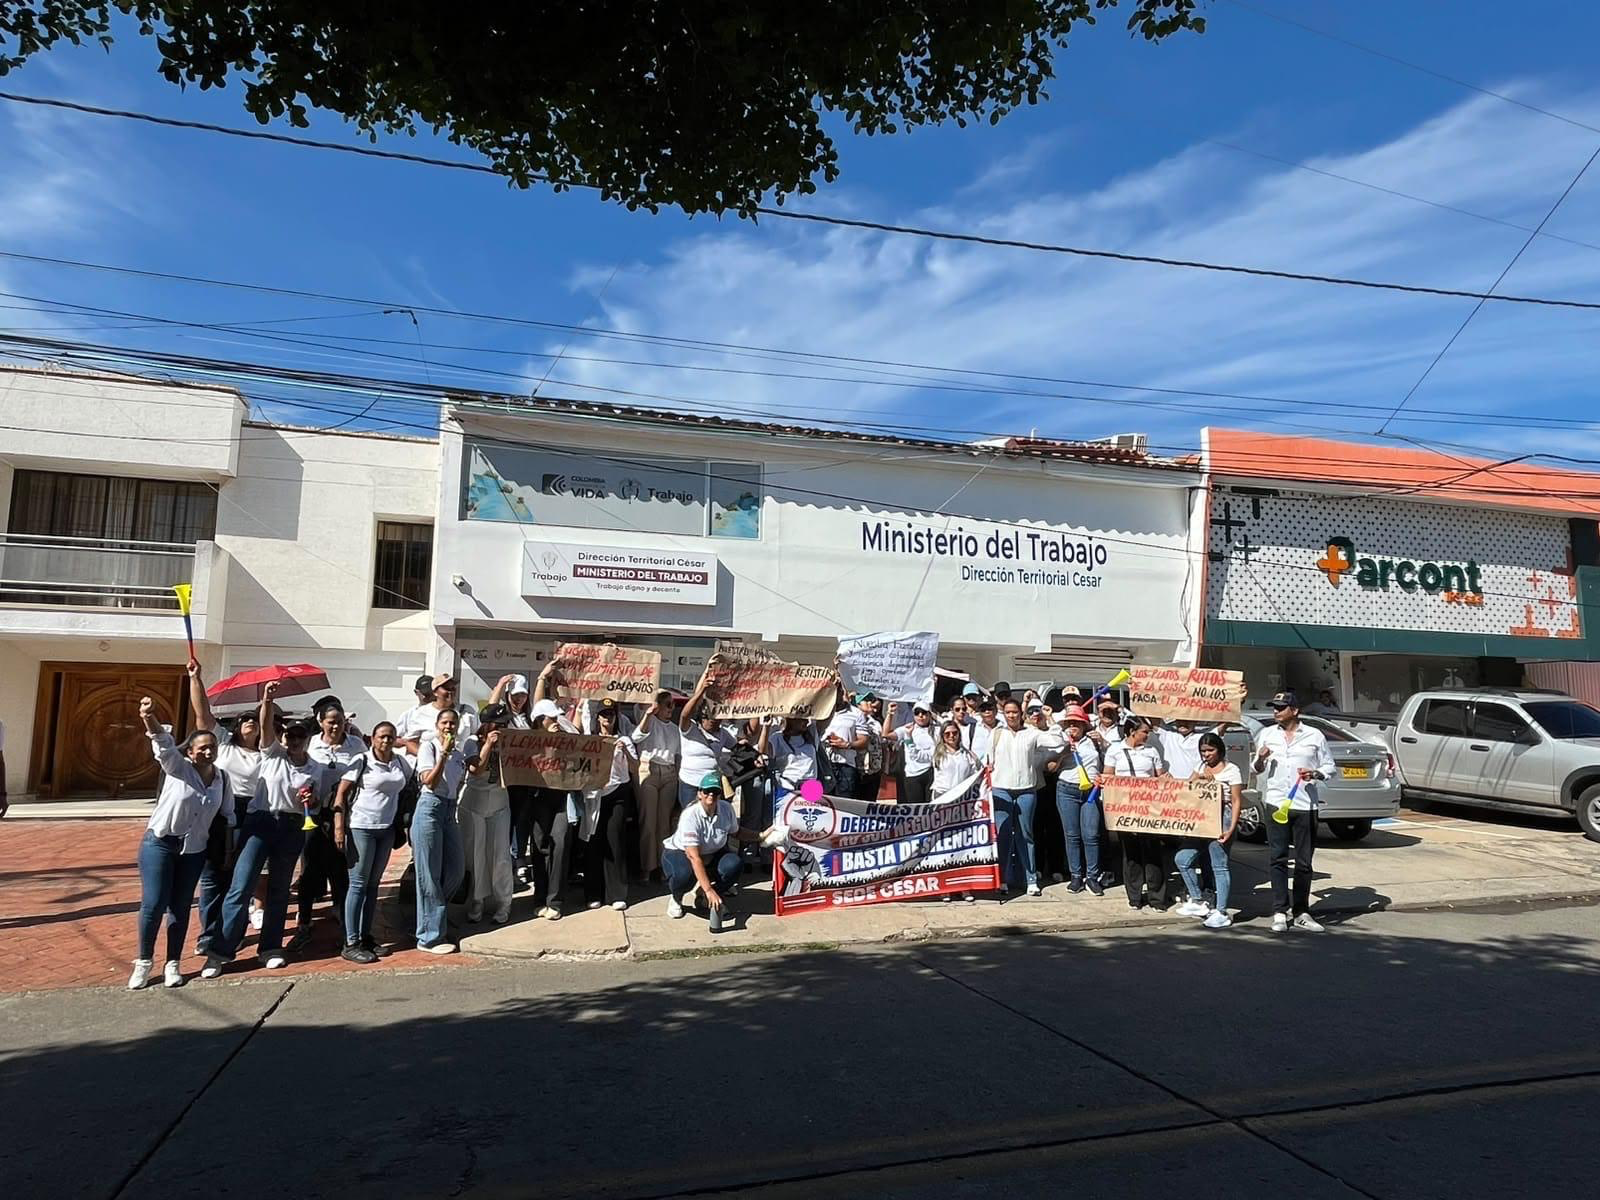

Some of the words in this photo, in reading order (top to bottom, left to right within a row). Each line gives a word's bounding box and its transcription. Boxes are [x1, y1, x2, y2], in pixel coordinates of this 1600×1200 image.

[571, 488, 605, 499] VIDA
[648, 487, 693, 502] Trabajo
[862, 521, 978, 557] Ministerio
[985, 529, 1020, 560] del
[1026, 533, 1107, 571] Trabajo
[578, 552, 625, 563] Dirección
[629, 555, 675, 566] Territorial
[532, 572, 568, 583] Trabajo
[577, 567, 635, 579] MINISTERIO
[637, 569, 656, 580] DEL
[658, 571, 703, 583] TRABAJO
[961, 565, 1014, 583] Dirección
[1017, 568, 1070, 586] Territorial
[1072, 571, 1102, 588] Cesar
[597, 583, 624, 591] Trabajo
[625, 584, 645, 592] digno
[1187, 669, 1227, 686] ROTOS
[1132, 692, 1157, 704] PAGA
[1192, 687, 1207, 698] NO
[1209, 687, 1227, 700] LOS
[900, 840, 921, 861] DE
[832, 885, 877, 905] SEDE
[879, 876, 940, 898] CESAR
